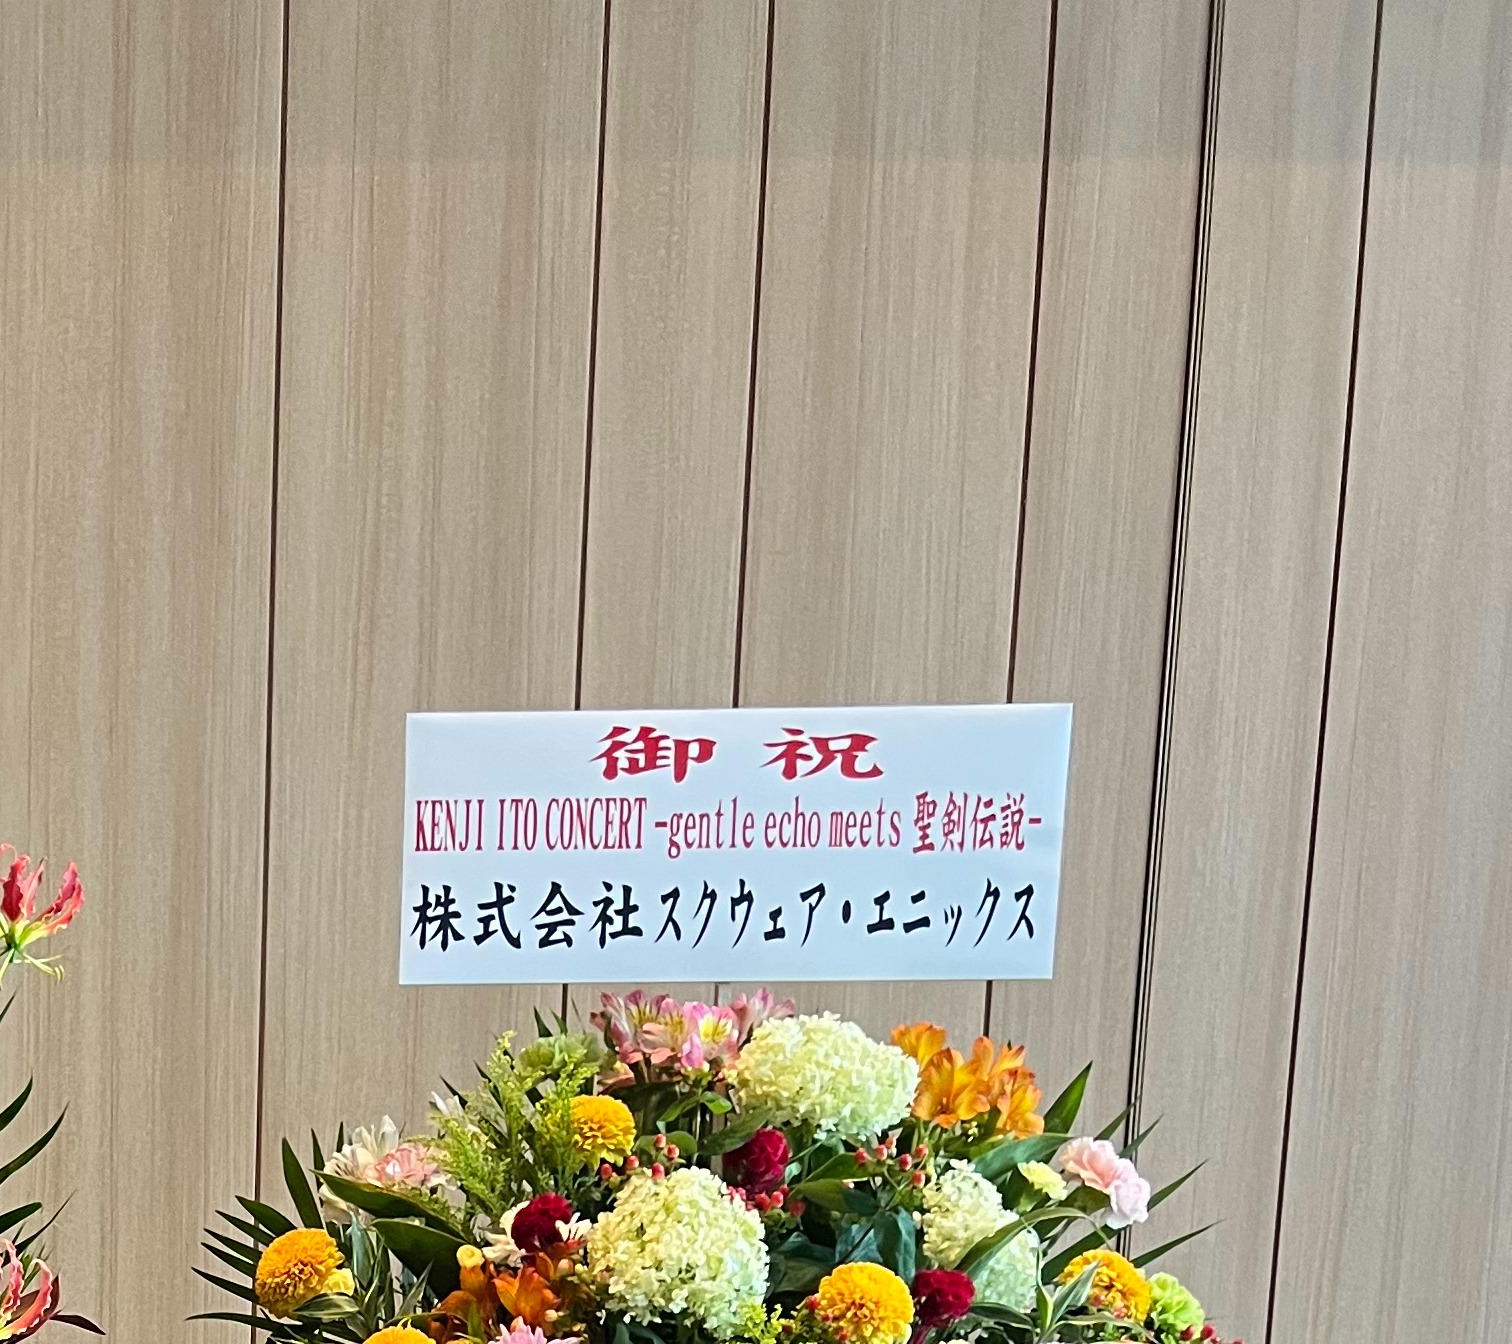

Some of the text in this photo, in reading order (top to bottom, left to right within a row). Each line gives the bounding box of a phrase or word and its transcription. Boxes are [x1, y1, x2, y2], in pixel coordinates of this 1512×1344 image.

[415, 791, 1043, 859] KENJI ITO CONCERT -gentle echo meets 聖剣伝説-
